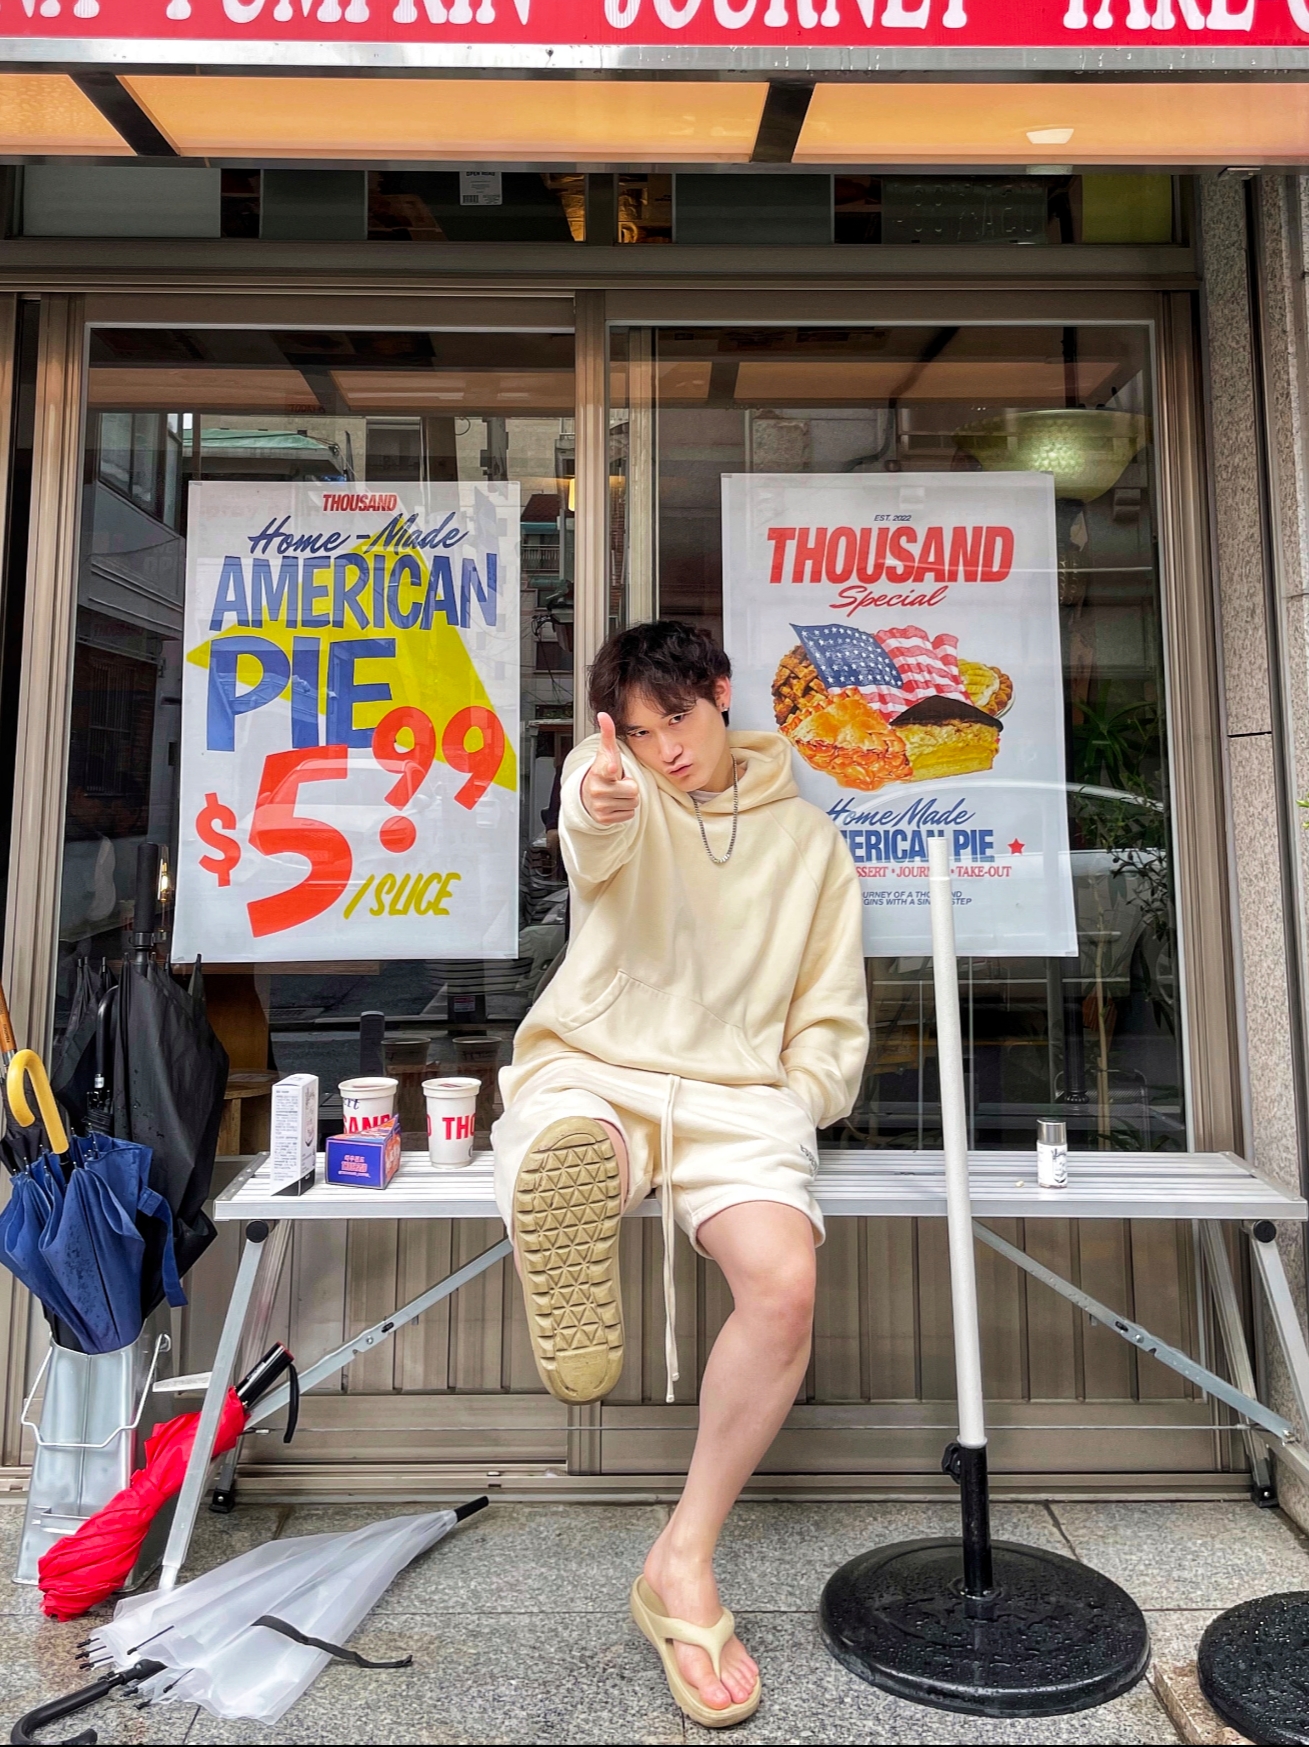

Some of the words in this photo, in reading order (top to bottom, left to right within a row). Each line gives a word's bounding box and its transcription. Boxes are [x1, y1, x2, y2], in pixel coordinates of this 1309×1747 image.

[323, 494, 397, 511] THOUSAND
[767, 526, 1014, 584] THOUSAND
[209, 553, 498, 631] AMERICAN
[829, 585, 948, 617] Special
[206, 636, 397, 752] PIE
[826, 797, 903, 827] Home
[891, 797, 976, 829] Made
[840, 829, 945, 863] ERICA
[953, 829, 995, 863] PIE
[896, 866, 930, 878] JOUR
[956, 866, 1012, 878] TAKE-OUT
[862, 891, 892, 899] URNEY
[893, 891, 906, 899] OF
[863, 898, 884, 906] GINS
[885, 898, 908, 906] WITH
[951, 897, 972, 906] STEP
